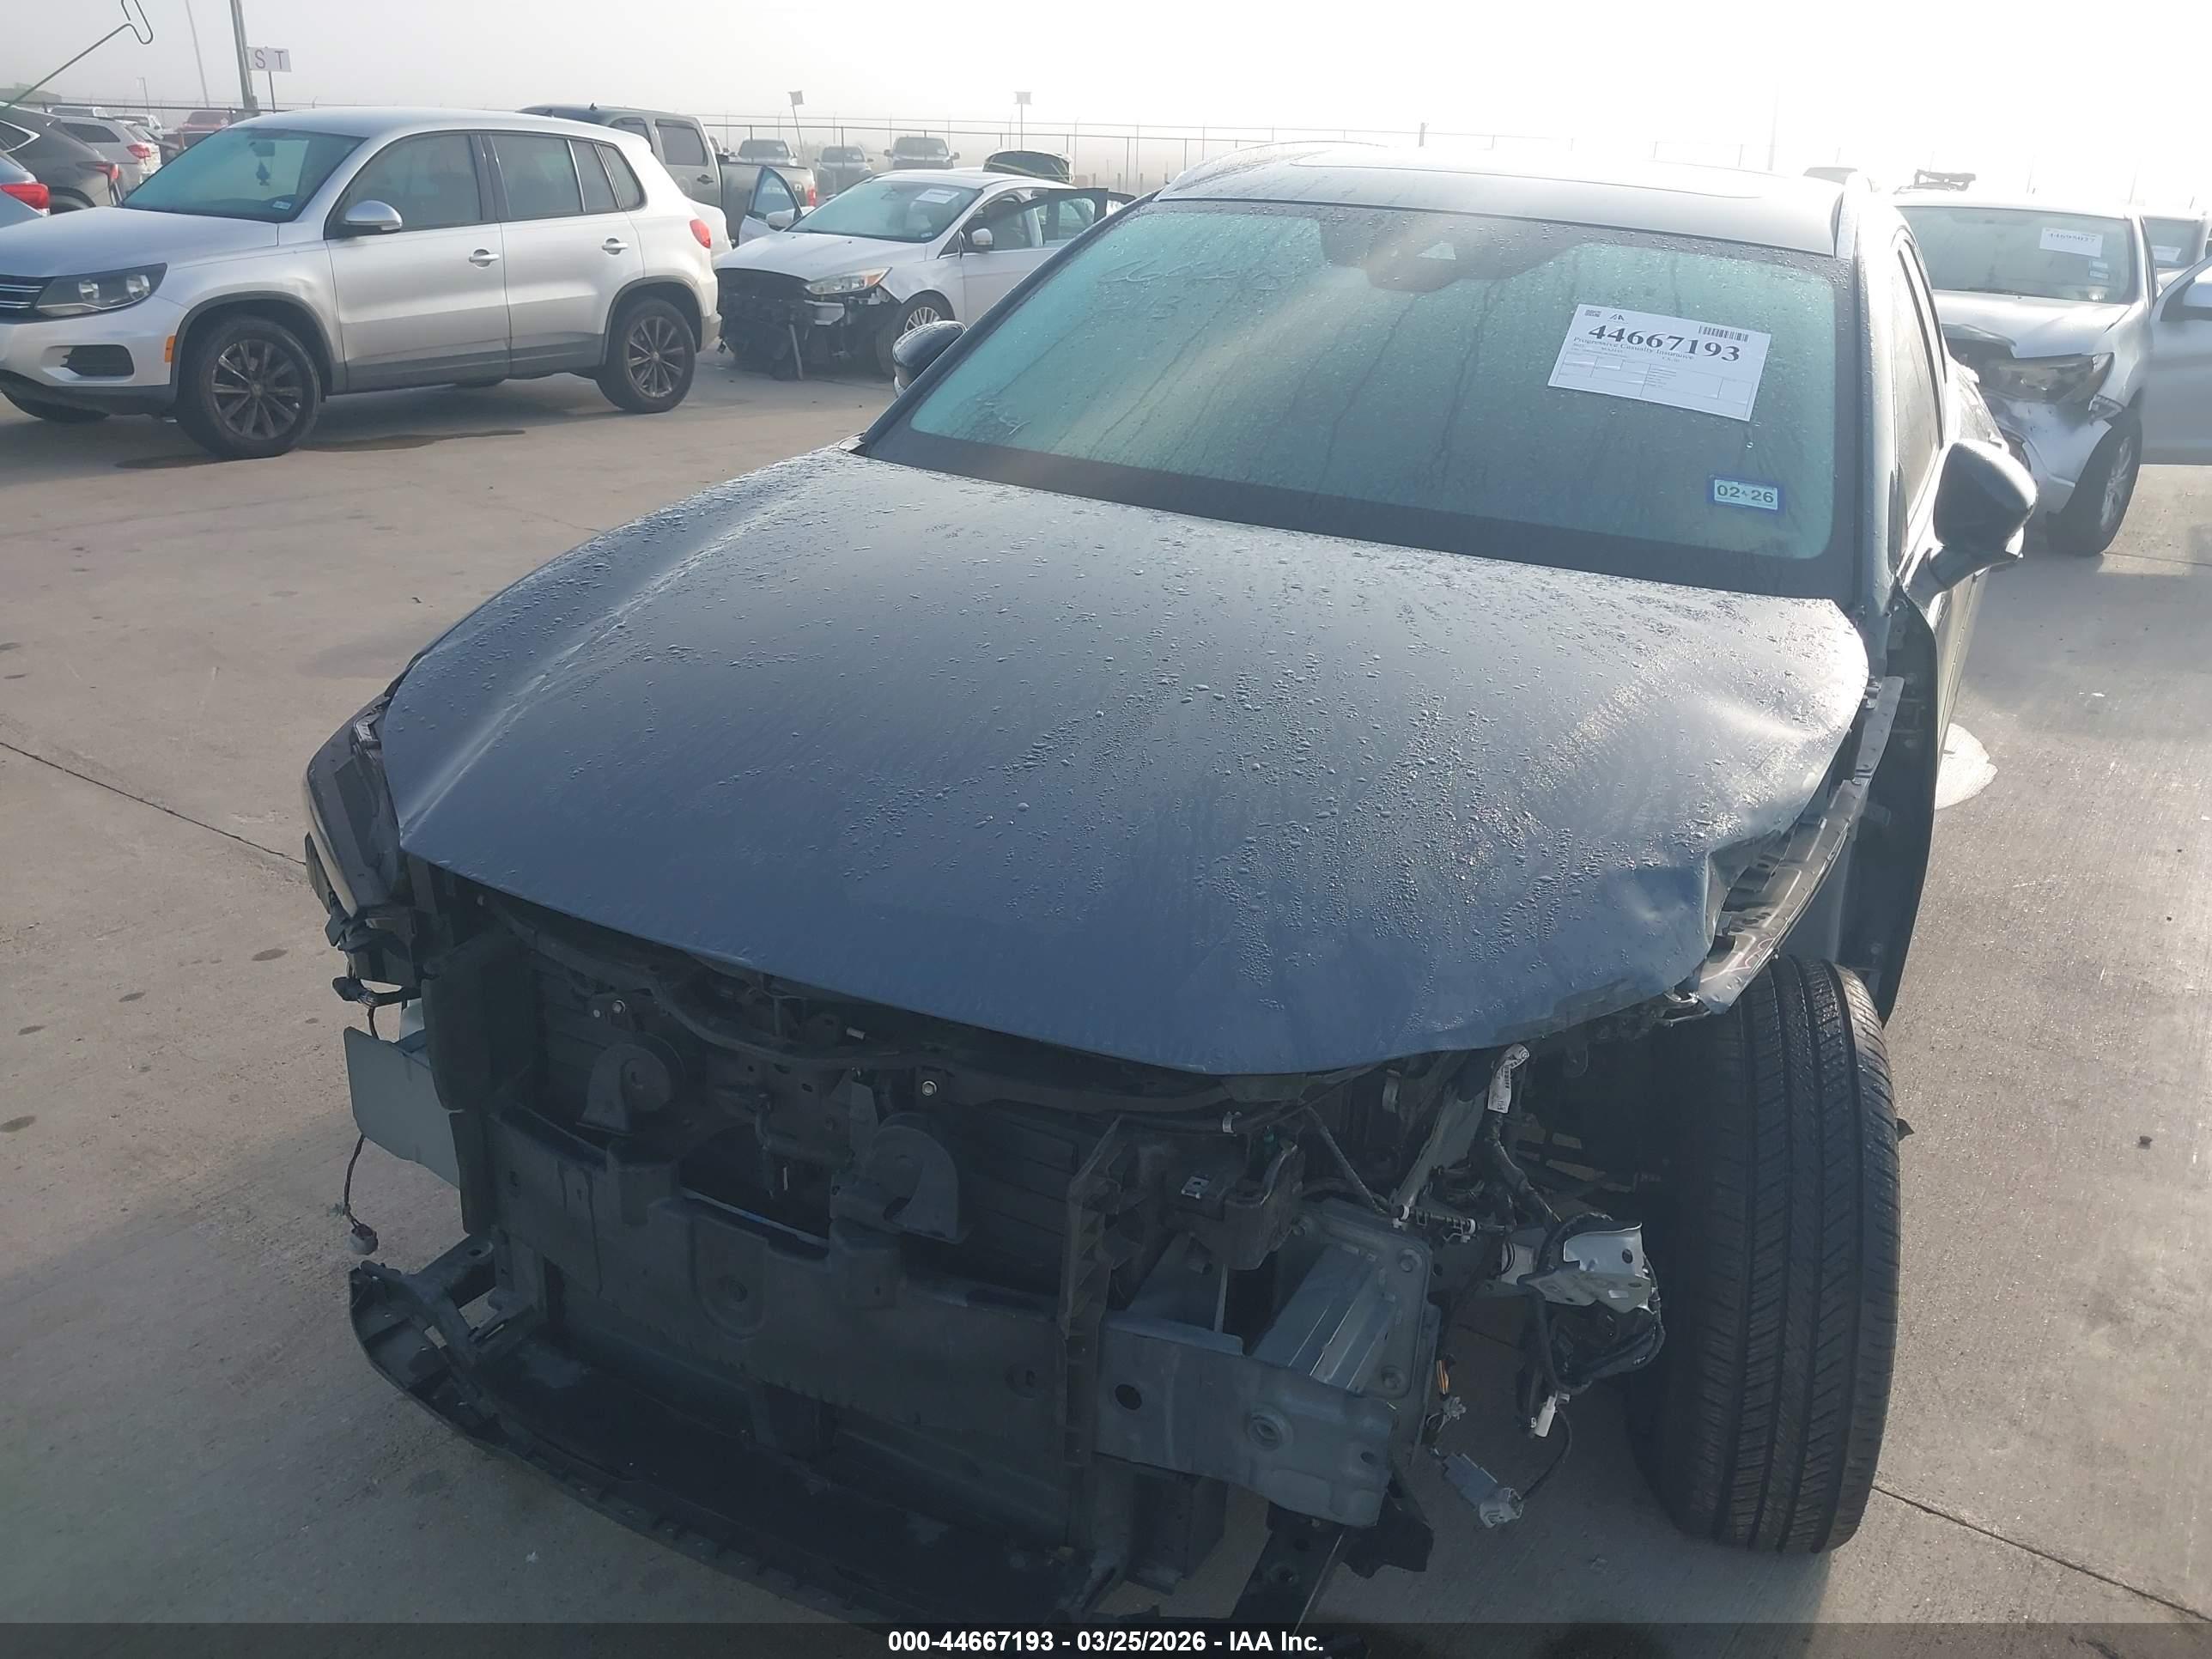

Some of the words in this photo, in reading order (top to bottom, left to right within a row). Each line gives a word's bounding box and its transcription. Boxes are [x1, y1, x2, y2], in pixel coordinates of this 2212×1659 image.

[254, 49, 265, 69] S
[275, 50, 284, 70] T
[1589, 325, 1741, 362] 44667193
[1717, 484, 1741, 498] 02
[1751, 489, 1774, 503] 26
